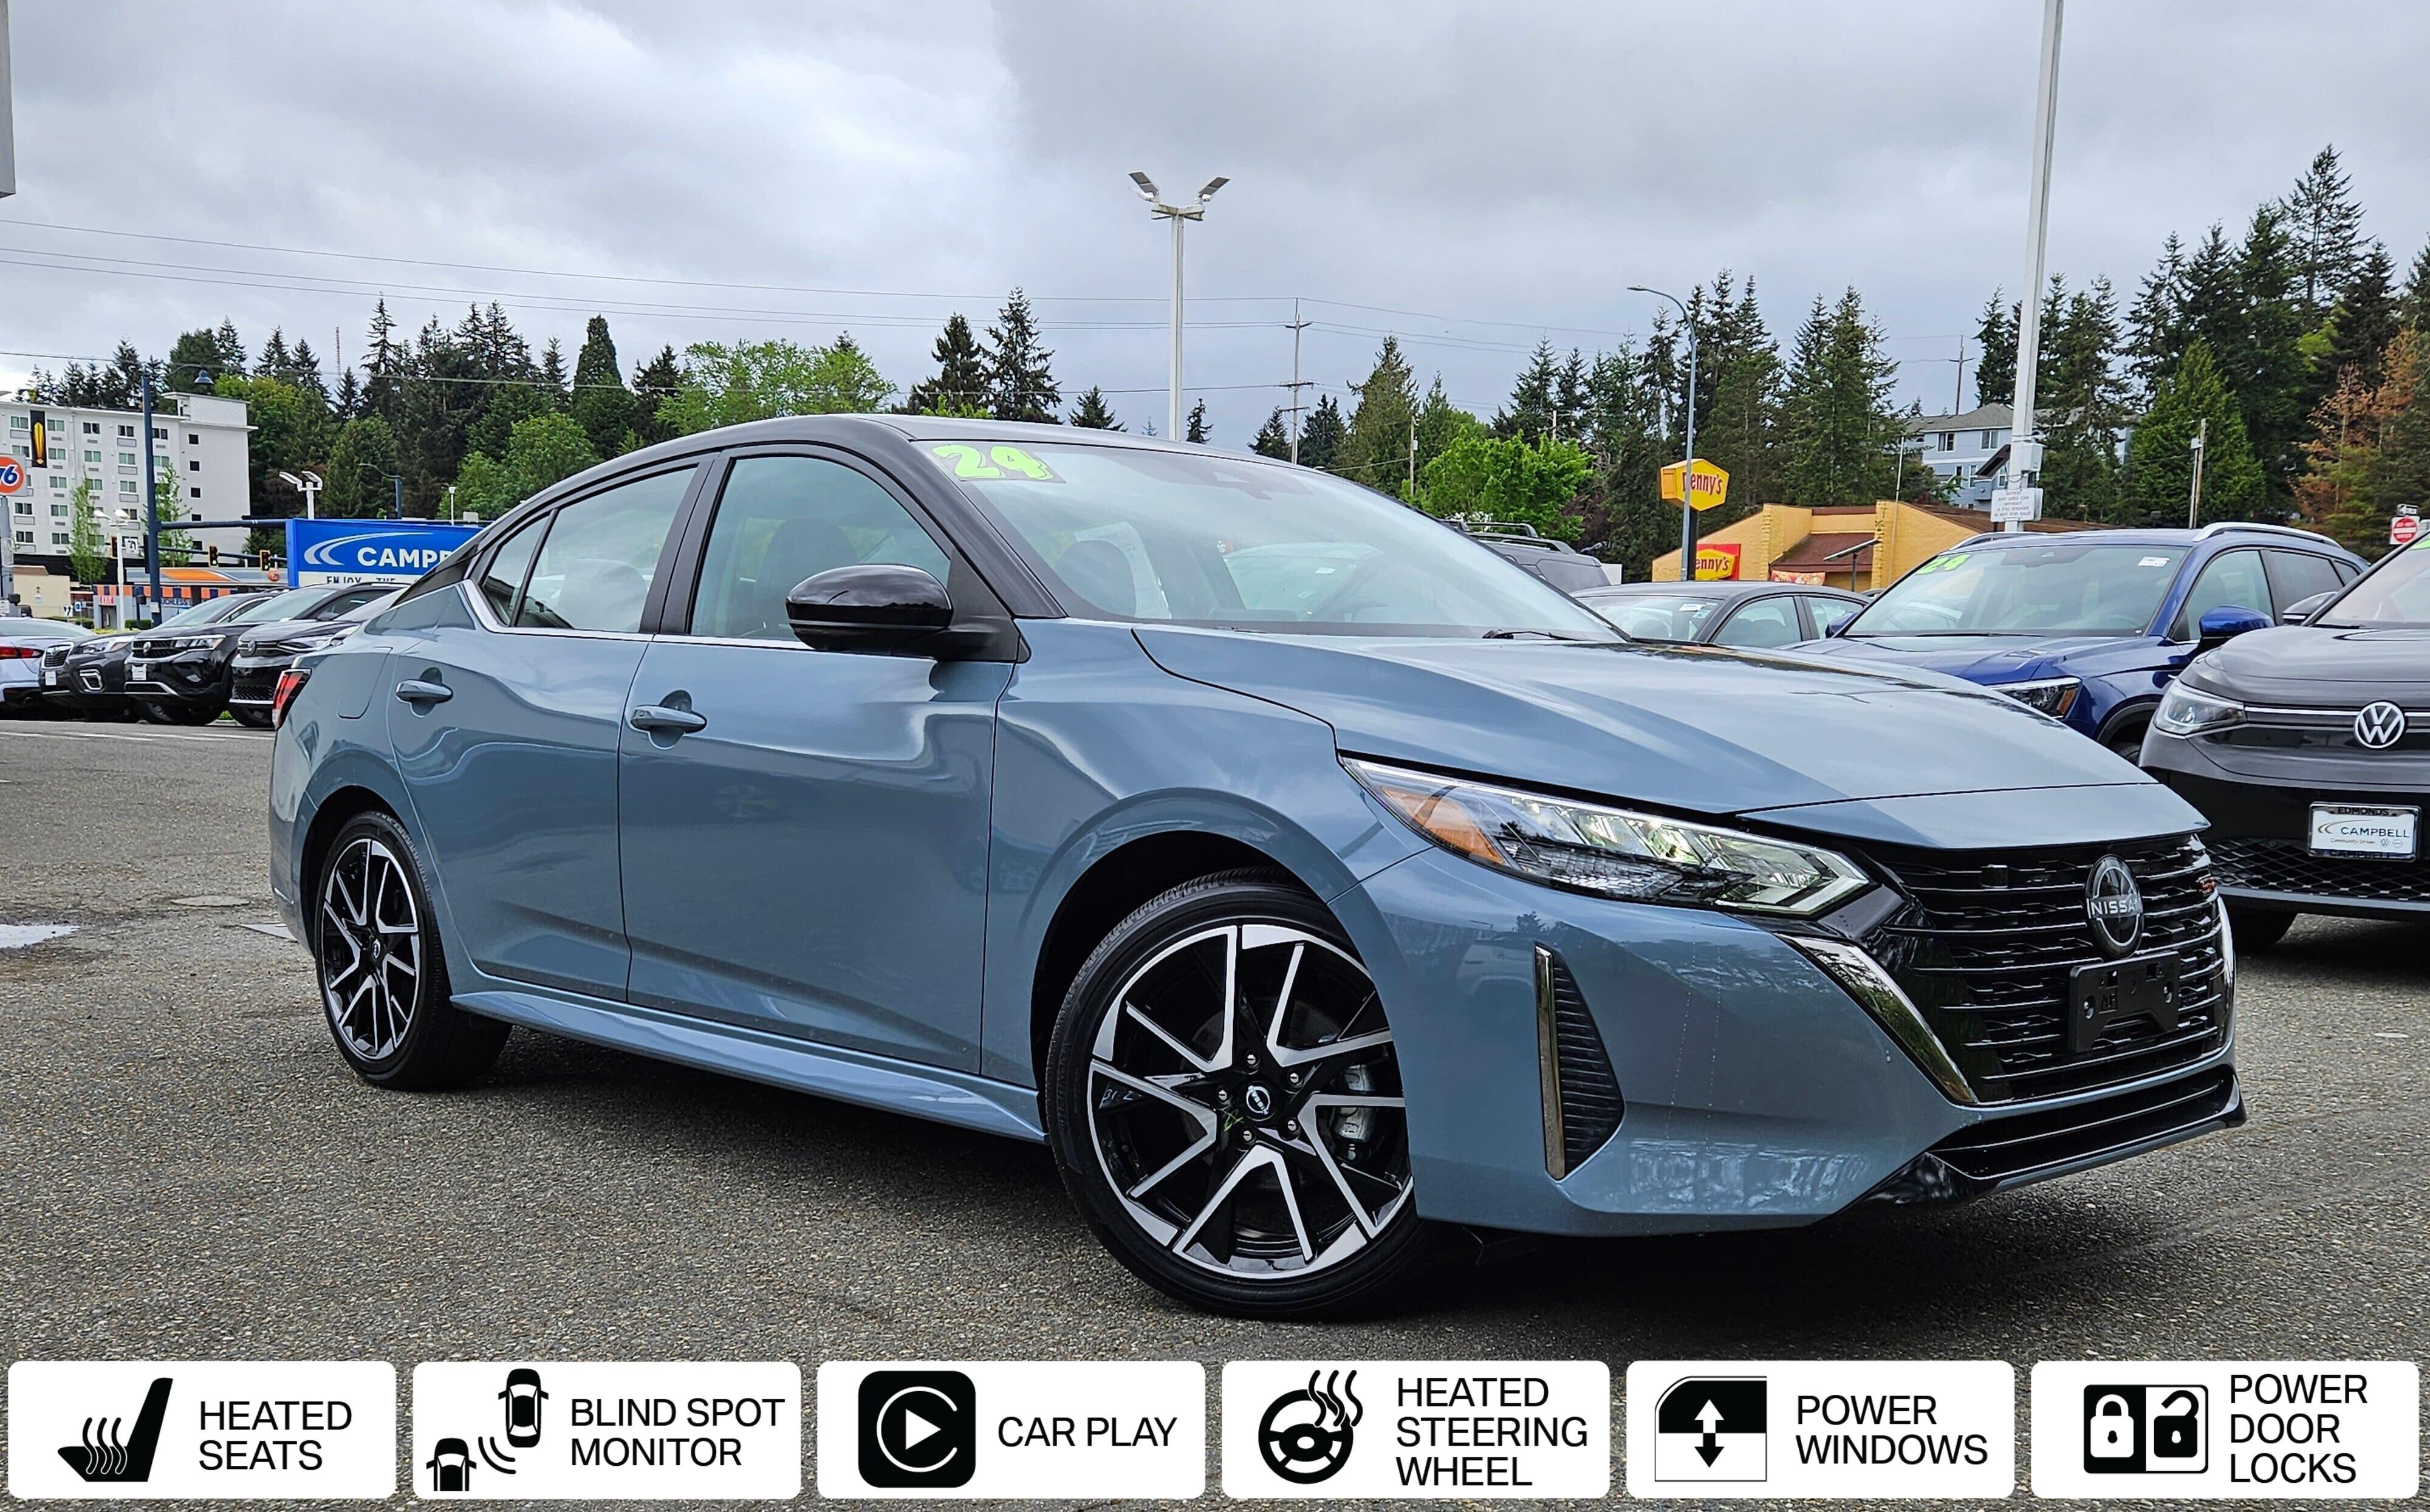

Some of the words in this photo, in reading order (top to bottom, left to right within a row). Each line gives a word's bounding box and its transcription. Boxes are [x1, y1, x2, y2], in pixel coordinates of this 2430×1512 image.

[932, 445, 1054, 480] 24
[1696, 556, 1730, 572] enny's
[2338, 807, 2389, 816] EDMONDS
[2341, 826, 2410, 838] CAMPBELL
